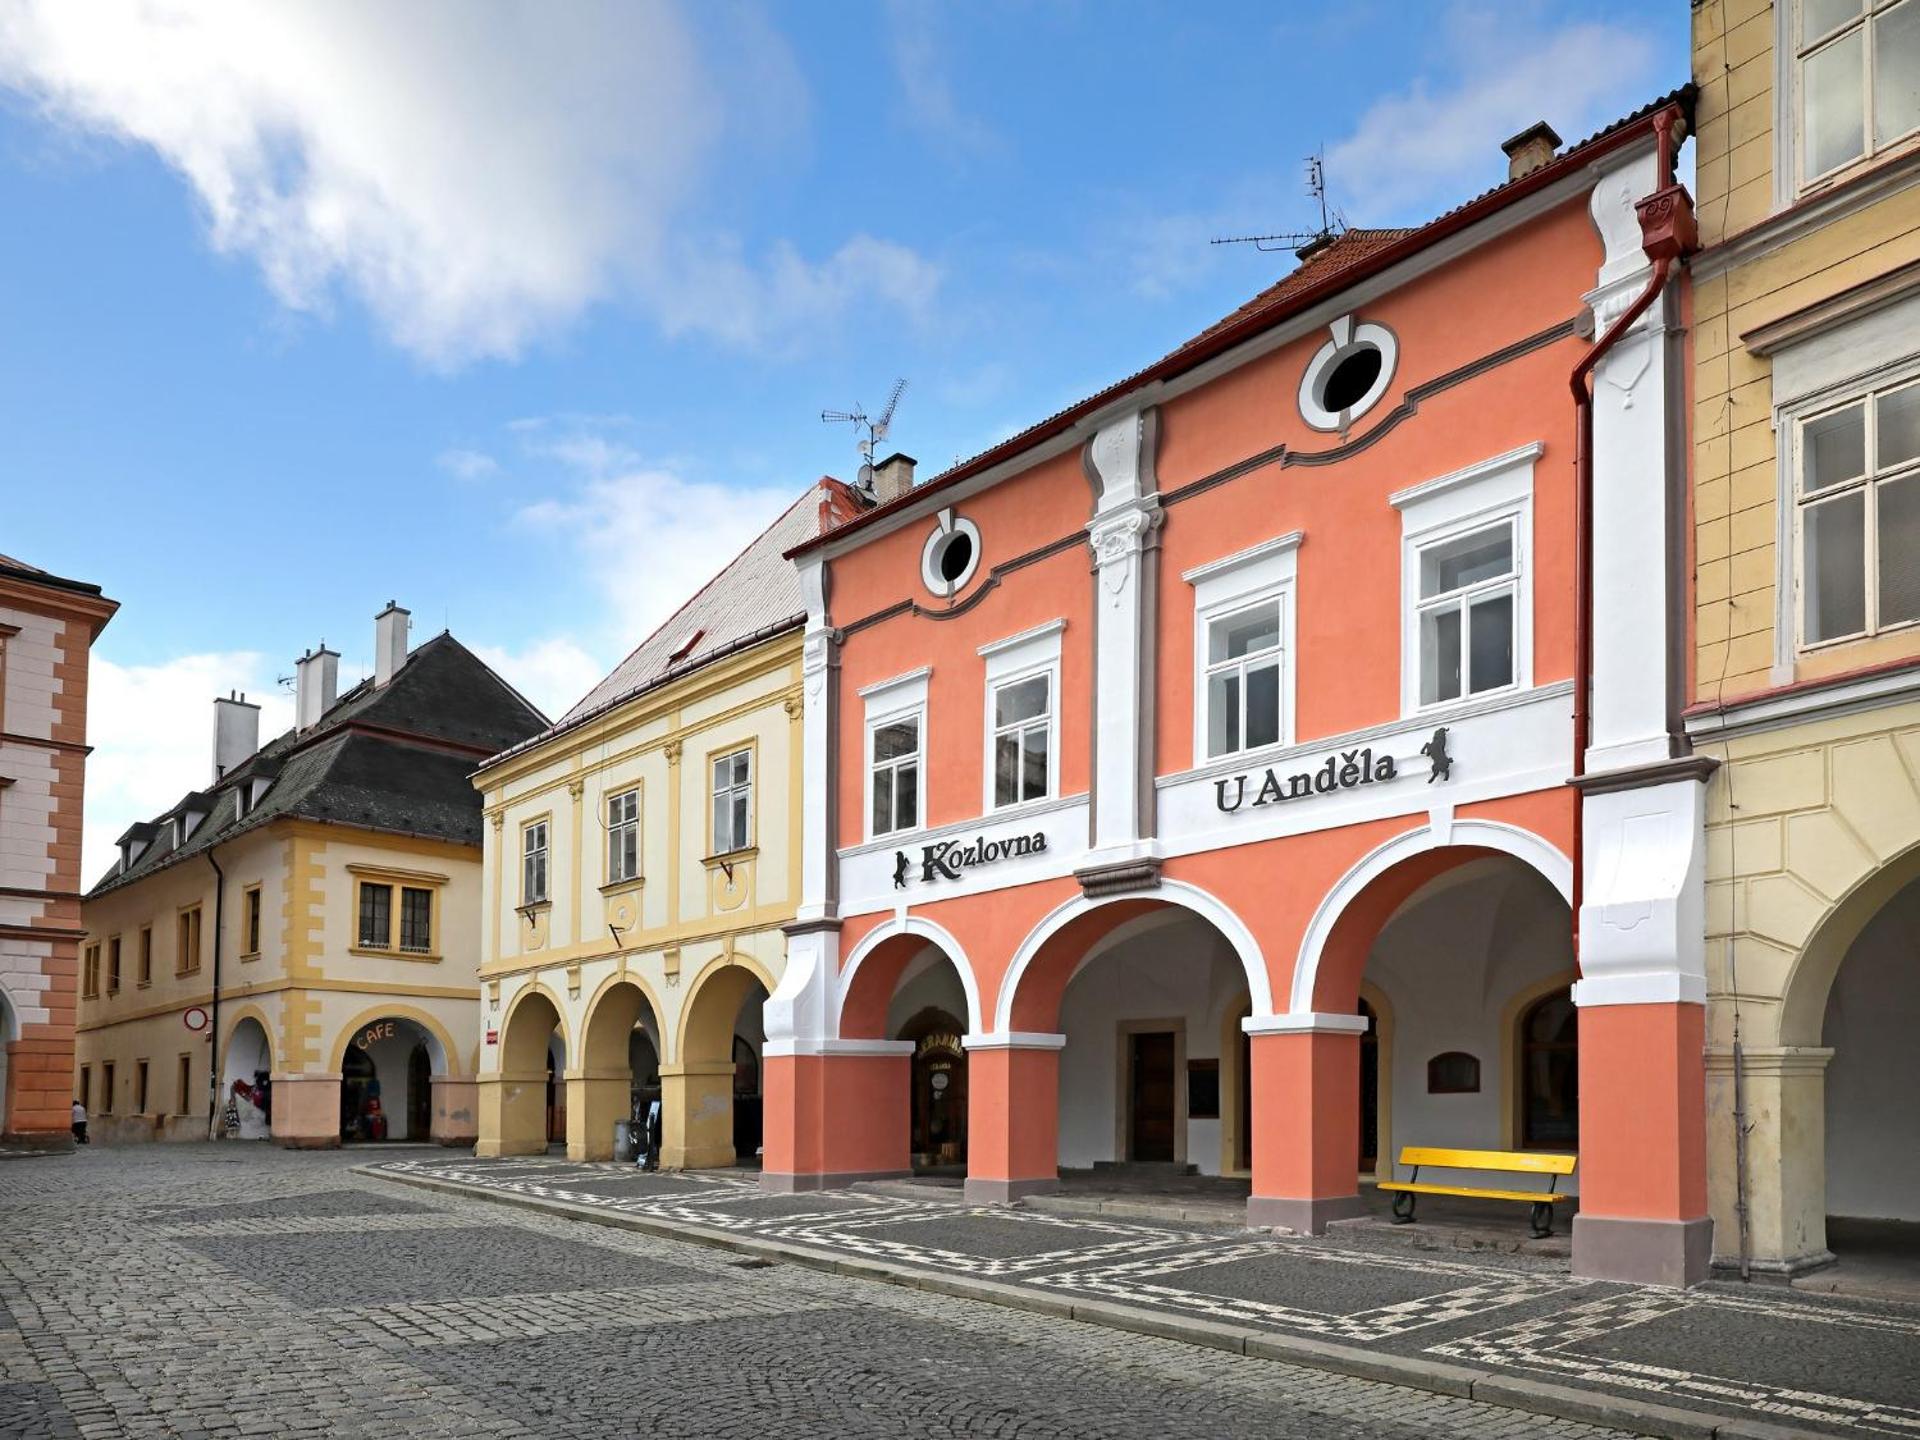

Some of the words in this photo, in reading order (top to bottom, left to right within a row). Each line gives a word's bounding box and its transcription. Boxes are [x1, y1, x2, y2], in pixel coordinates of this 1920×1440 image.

[1213, 775, 1248, 812] U
[1252, 748, 1398, 806] Anděla
[920, 831, 1047, 882] Kozlovna
[356, 1022, 395, 1050] CAFE
